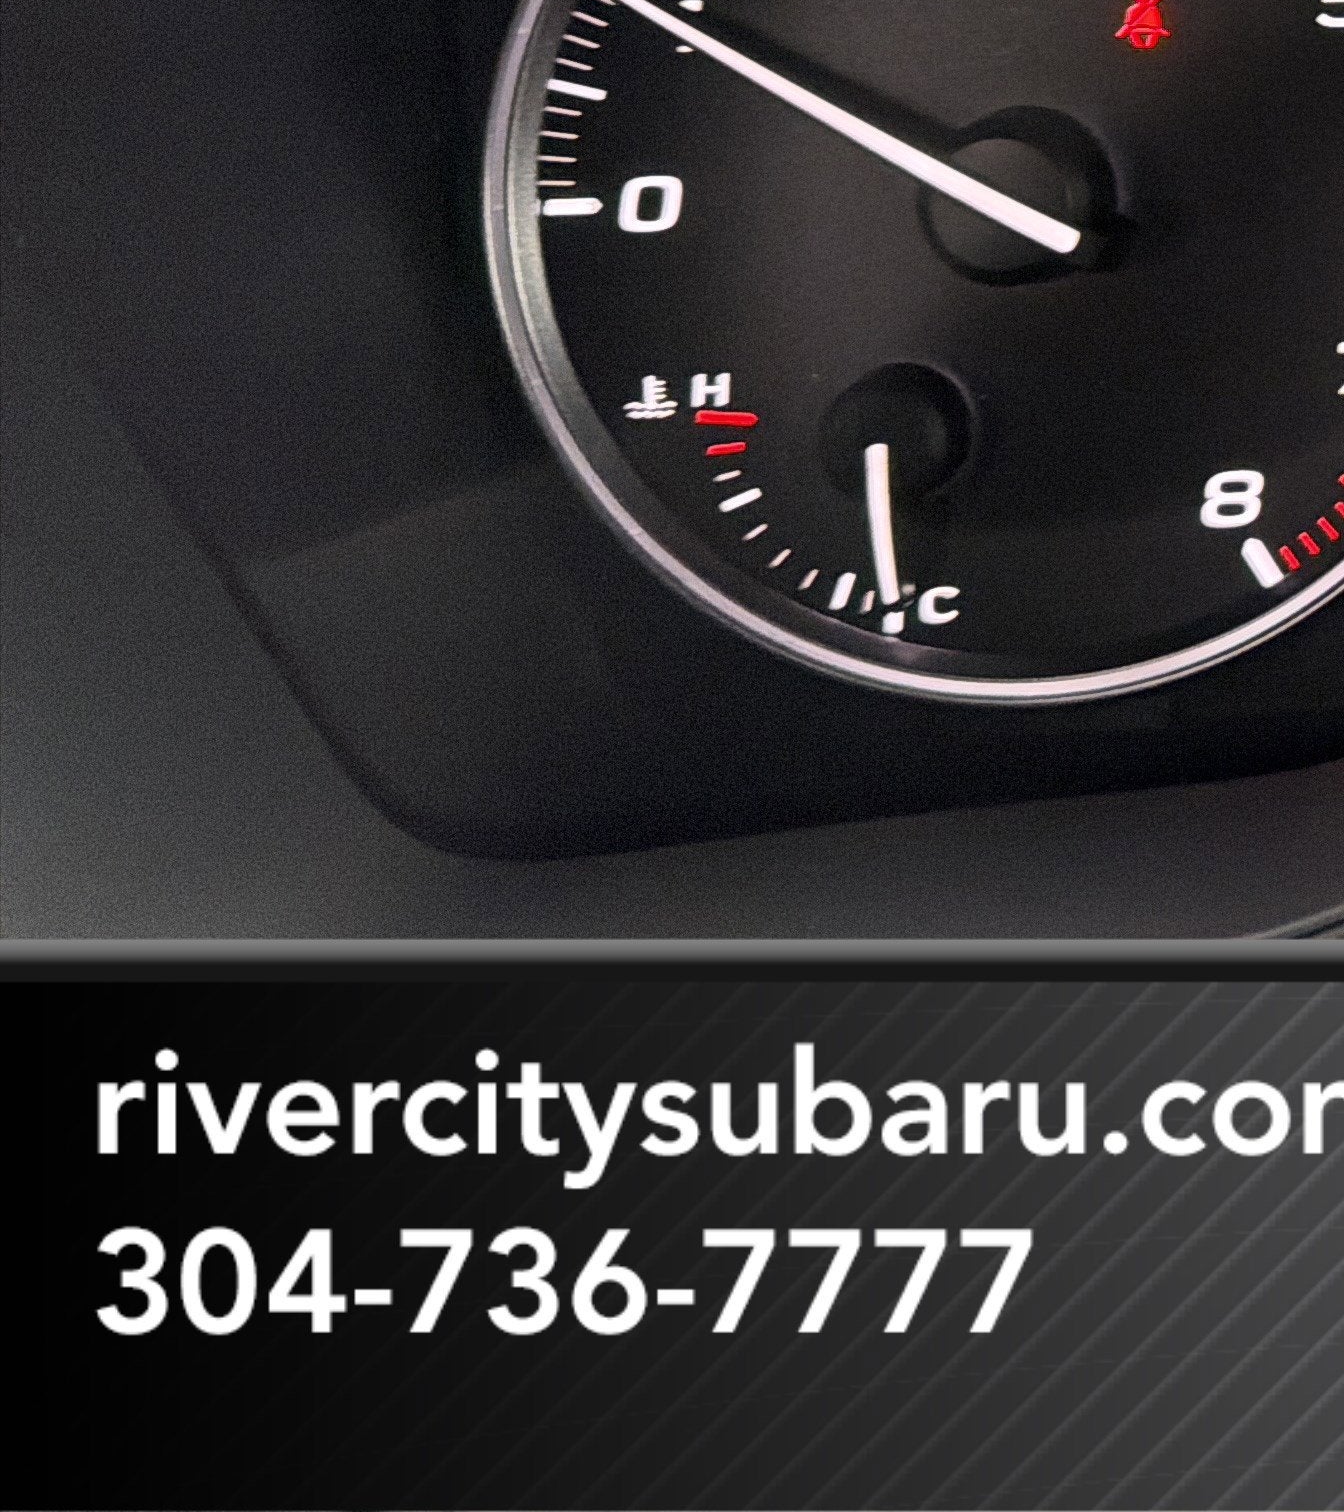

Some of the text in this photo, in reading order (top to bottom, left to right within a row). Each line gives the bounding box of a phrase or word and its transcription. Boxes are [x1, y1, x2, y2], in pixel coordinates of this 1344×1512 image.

[616, 174, 685, 234] 0
[689, 371, 732, 409] H
[1198, 468, 1266, 530] 8
[916, 584, 962, 626] C
